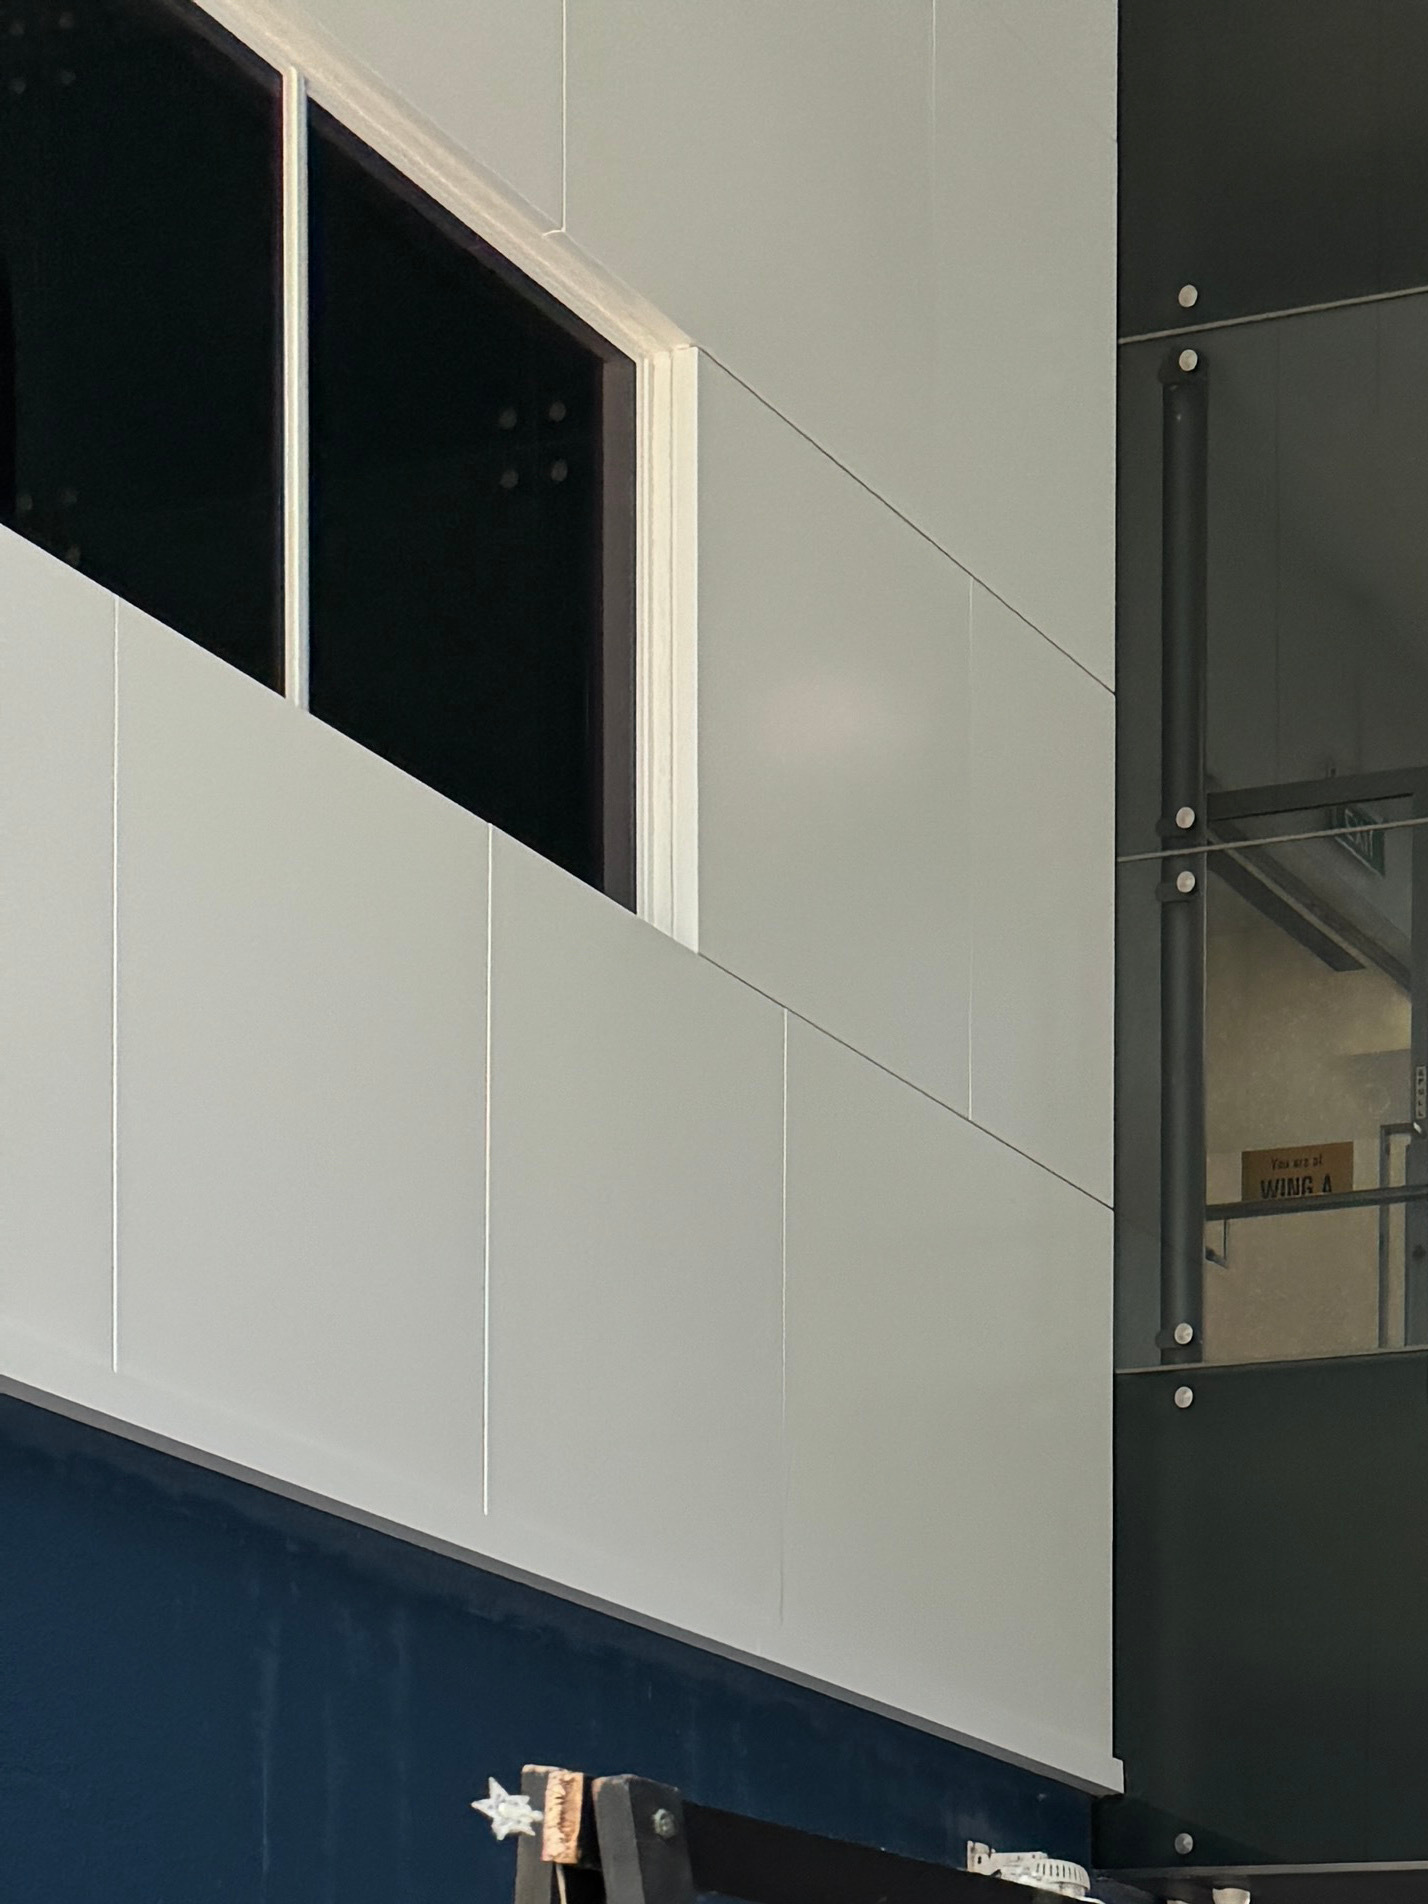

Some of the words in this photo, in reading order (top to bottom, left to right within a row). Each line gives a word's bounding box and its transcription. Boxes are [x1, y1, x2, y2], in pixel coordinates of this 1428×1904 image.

[1270, 1157, 1290, 1171] You
[1261, 1175, 1314, 1200] WING
[1322, 1173, 1334, 1194] A
